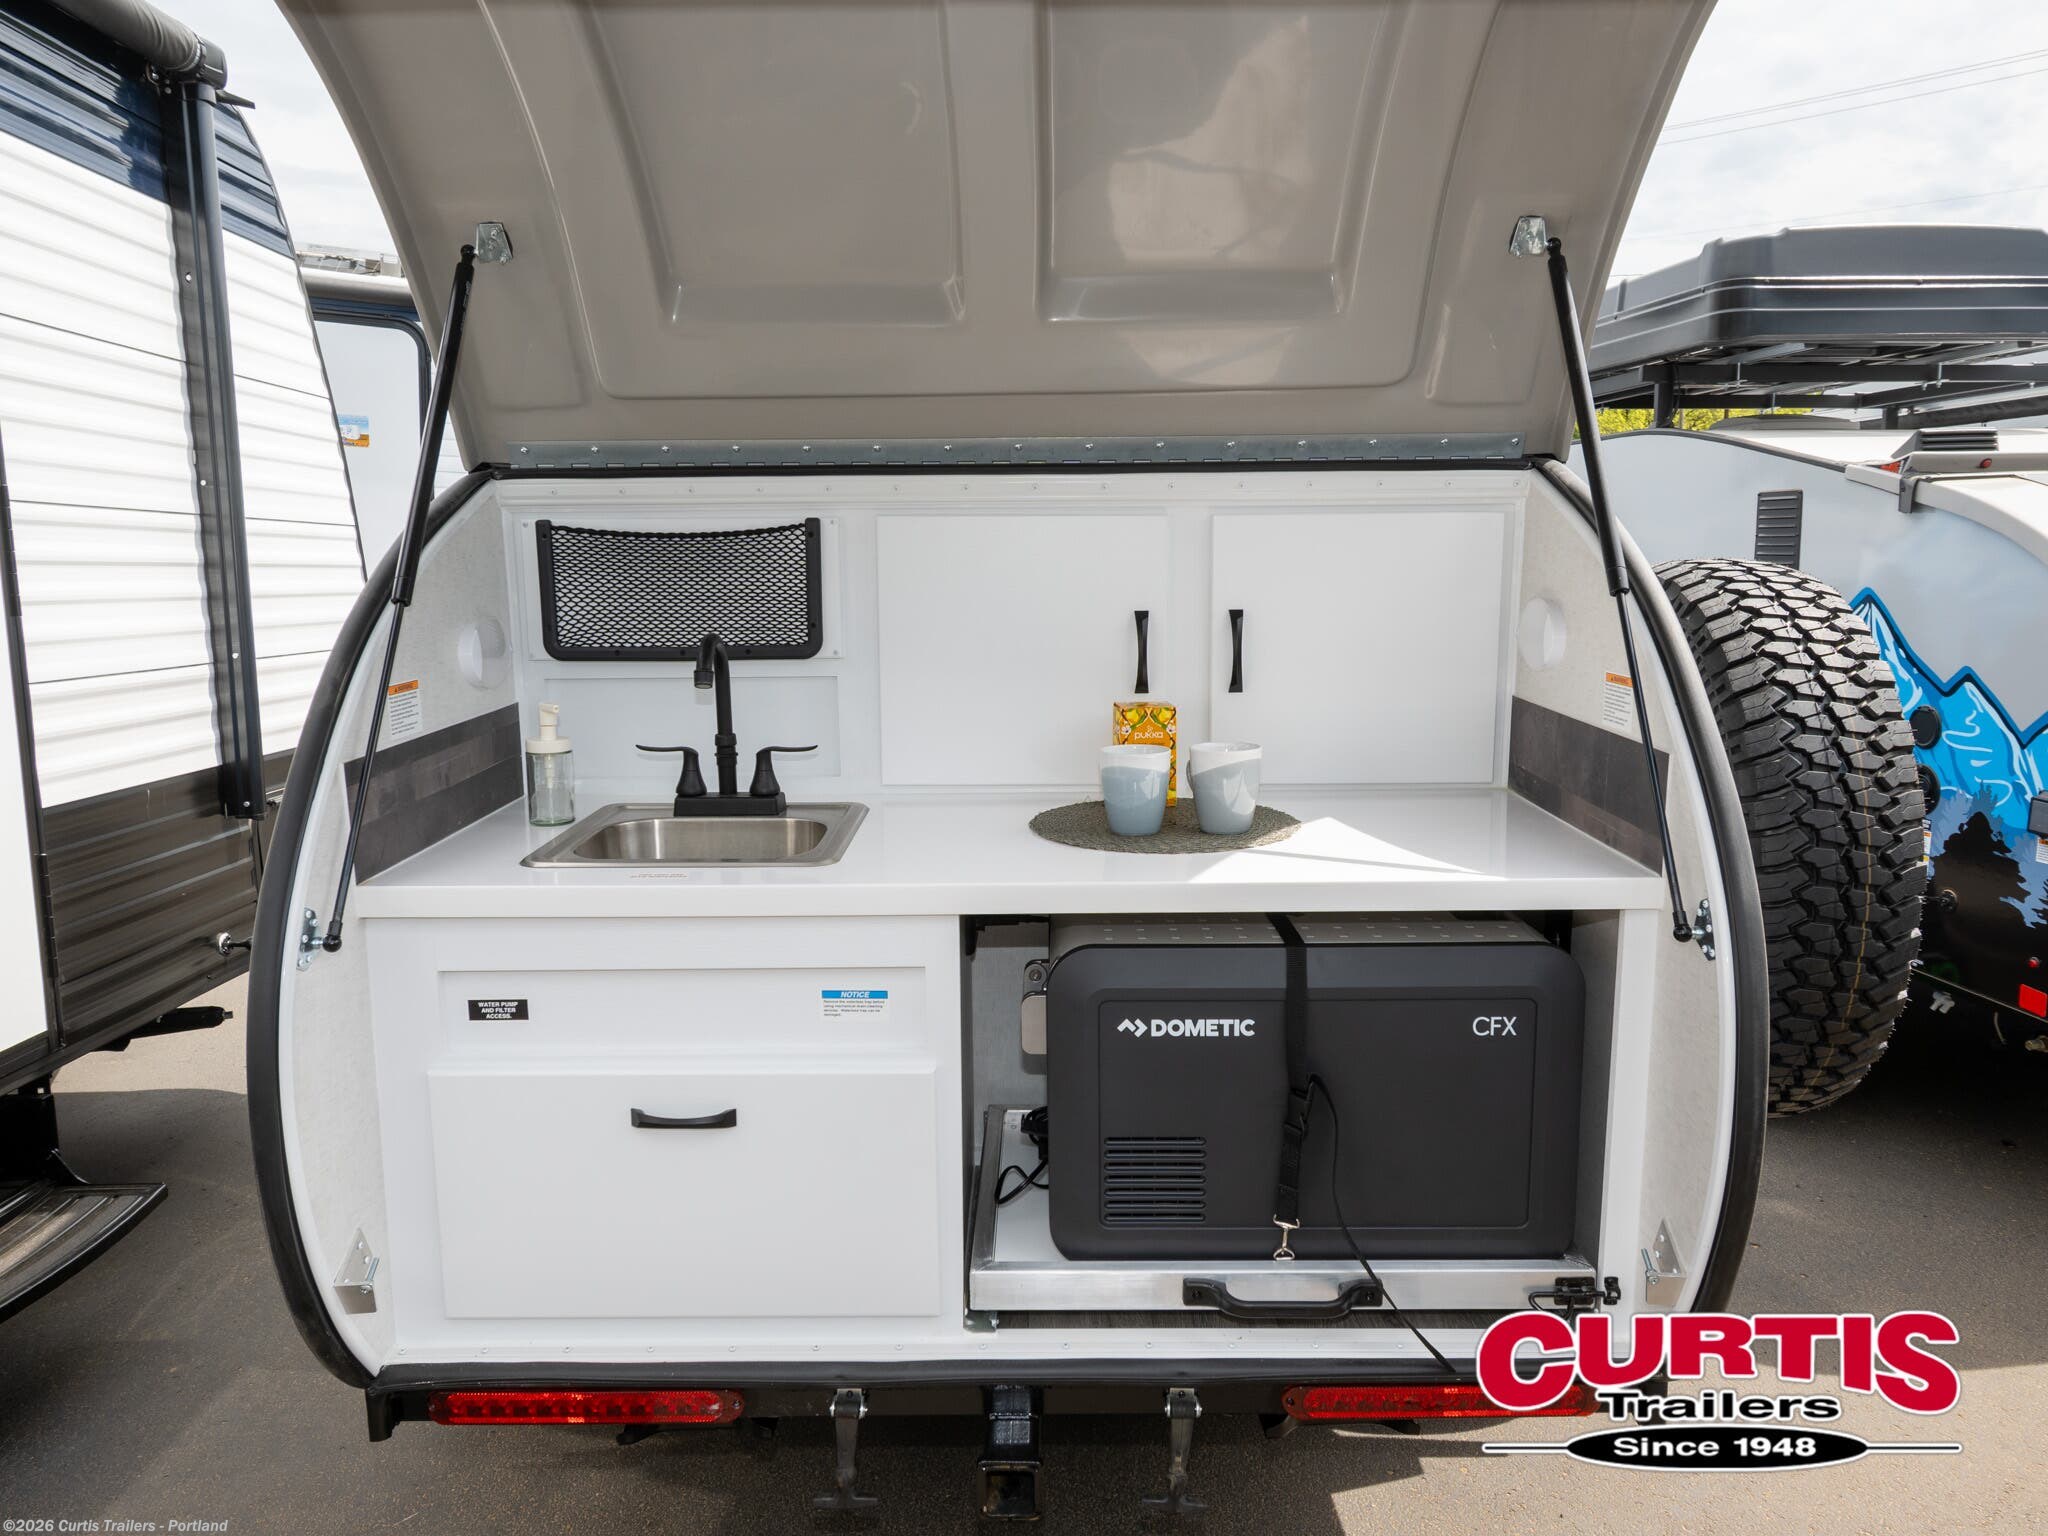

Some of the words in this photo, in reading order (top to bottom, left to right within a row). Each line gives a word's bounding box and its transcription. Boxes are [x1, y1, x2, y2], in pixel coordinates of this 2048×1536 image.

[1134, 731, 1164, 740] pukka
[1151, 1019, 1255, 1037] DOMETIC
[1472, 1016, 1517, 1036] CFX
